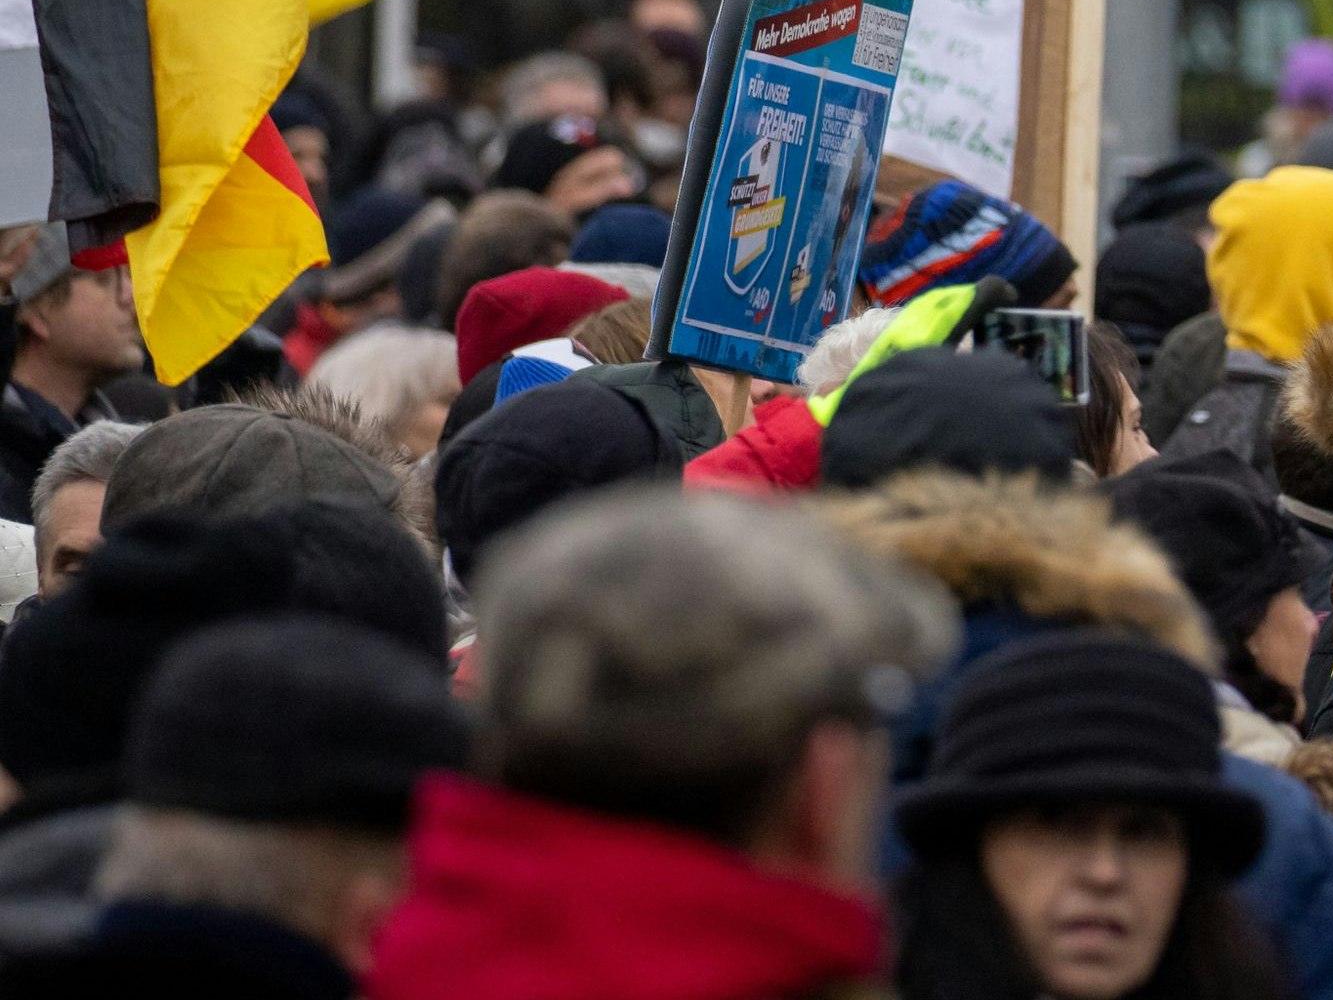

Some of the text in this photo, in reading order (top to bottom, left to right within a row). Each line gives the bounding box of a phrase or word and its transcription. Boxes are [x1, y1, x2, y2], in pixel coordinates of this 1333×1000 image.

[755, 23, 780, 51] Mehr
[780, 9, 830, 44] Demokratie
[831, 5, 857, 31] wagen
[748, 73, 765, 99] FÜR
[756, 105, 807, 147] FREIHEIT!
[751, 286, 770, 310] AfD
[818, 288, 836, 312] AfD
